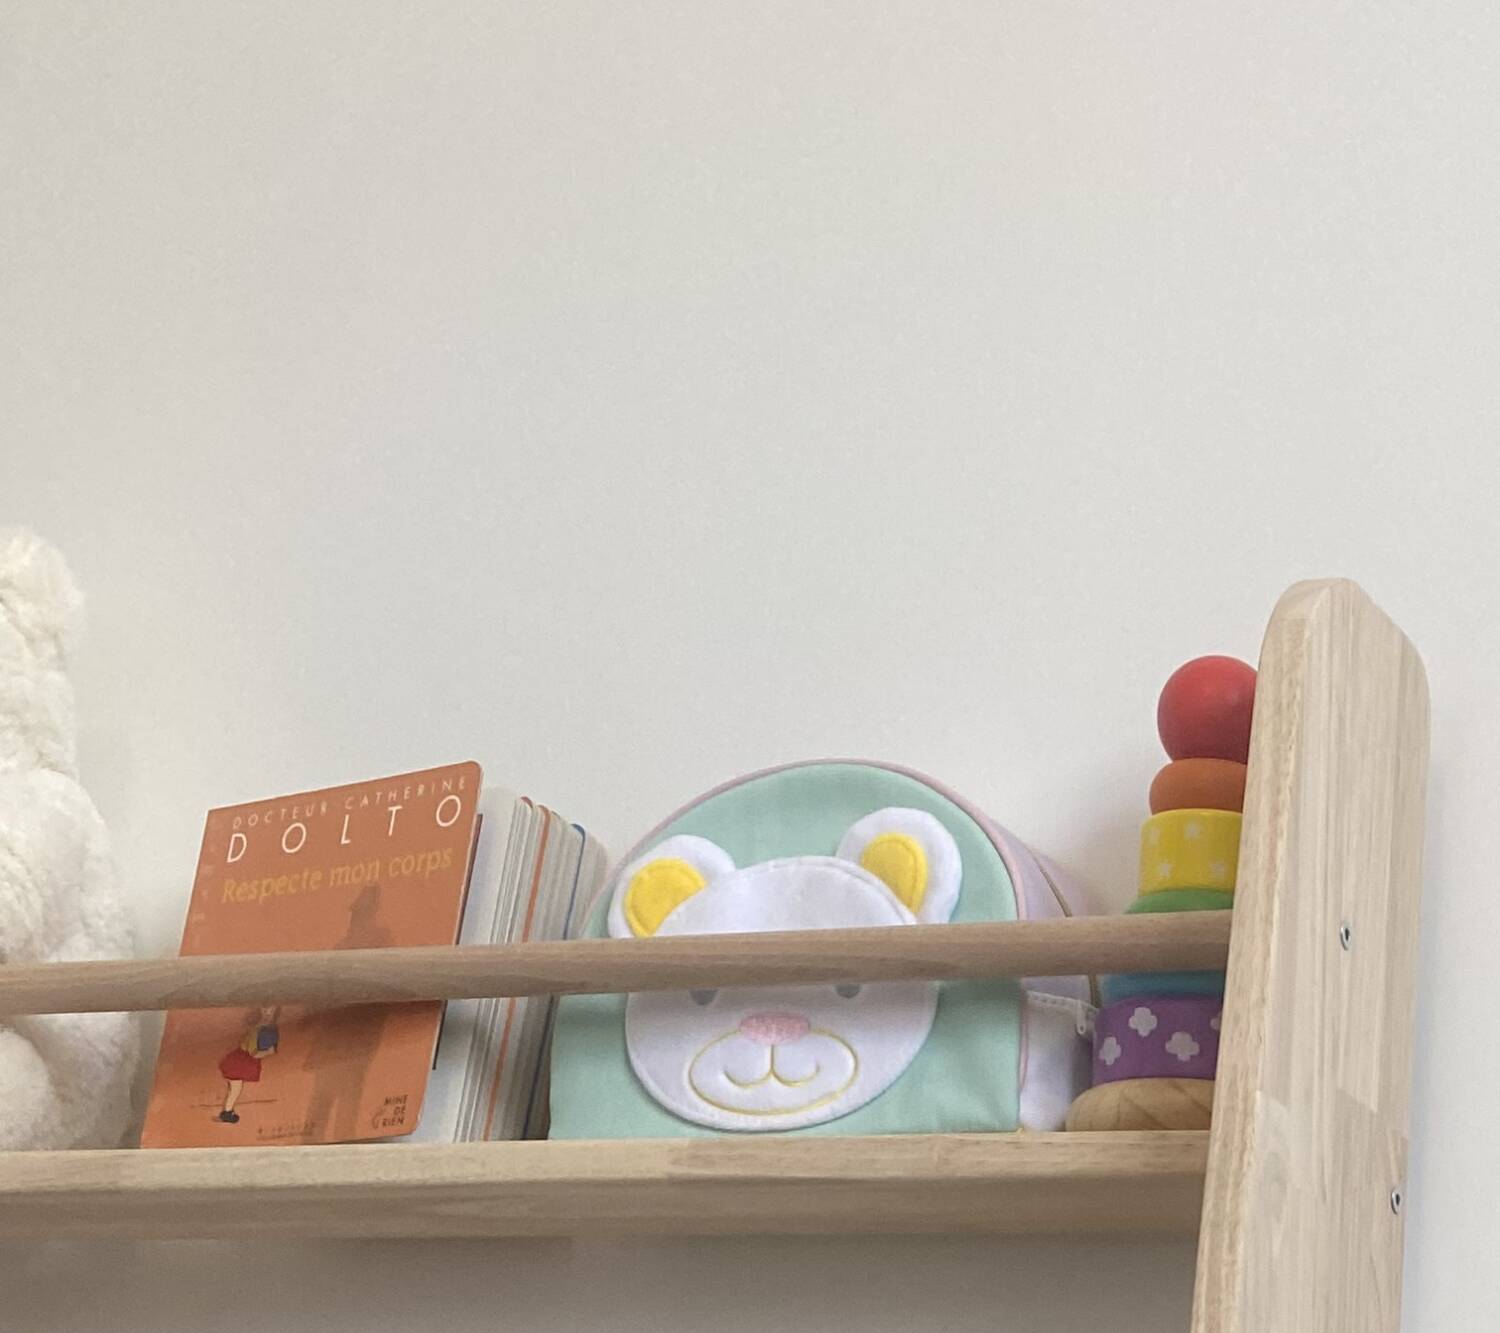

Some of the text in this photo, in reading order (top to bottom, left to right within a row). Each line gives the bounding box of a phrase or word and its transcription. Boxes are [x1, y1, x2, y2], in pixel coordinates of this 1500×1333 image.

[226, 794, 463, 863] DOLTO
[232, 776, 467, 830] DOCTEUR CATHERINE
[221, 846, 454, 903] Respecte mon corps
